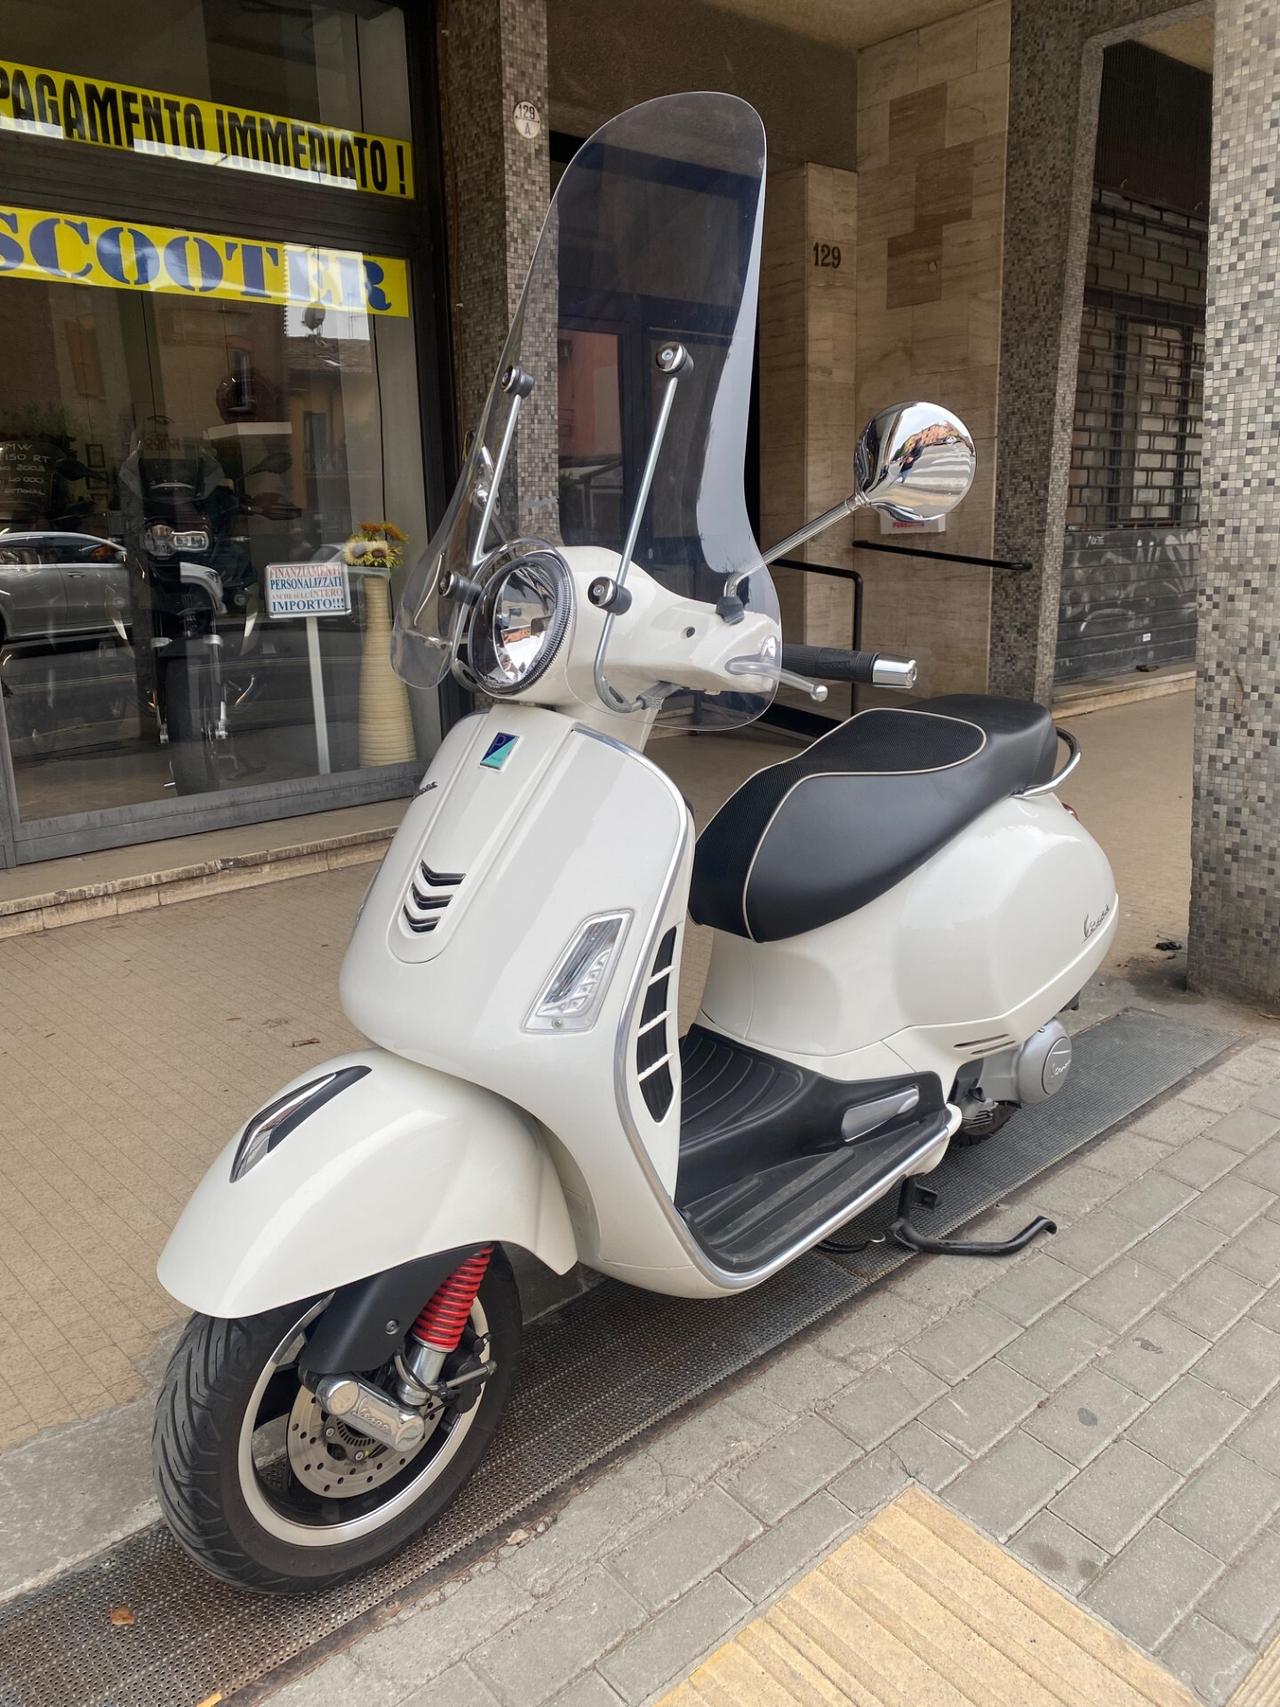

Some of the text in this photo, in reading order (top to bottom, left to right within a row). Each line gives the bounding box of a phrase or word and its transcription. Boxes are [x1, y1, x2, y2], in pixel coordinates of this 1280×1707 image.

[518, 103, 536, 120] 129
[215, 108, 388, 192] IMMEDIATO
[397, 144, 407, 196] !
[813, 241, 842, 269] 129
[270, 576, 343, 590] PERSONALIZZATI
[272, 598, 345, 612] IMPORTO!!!
